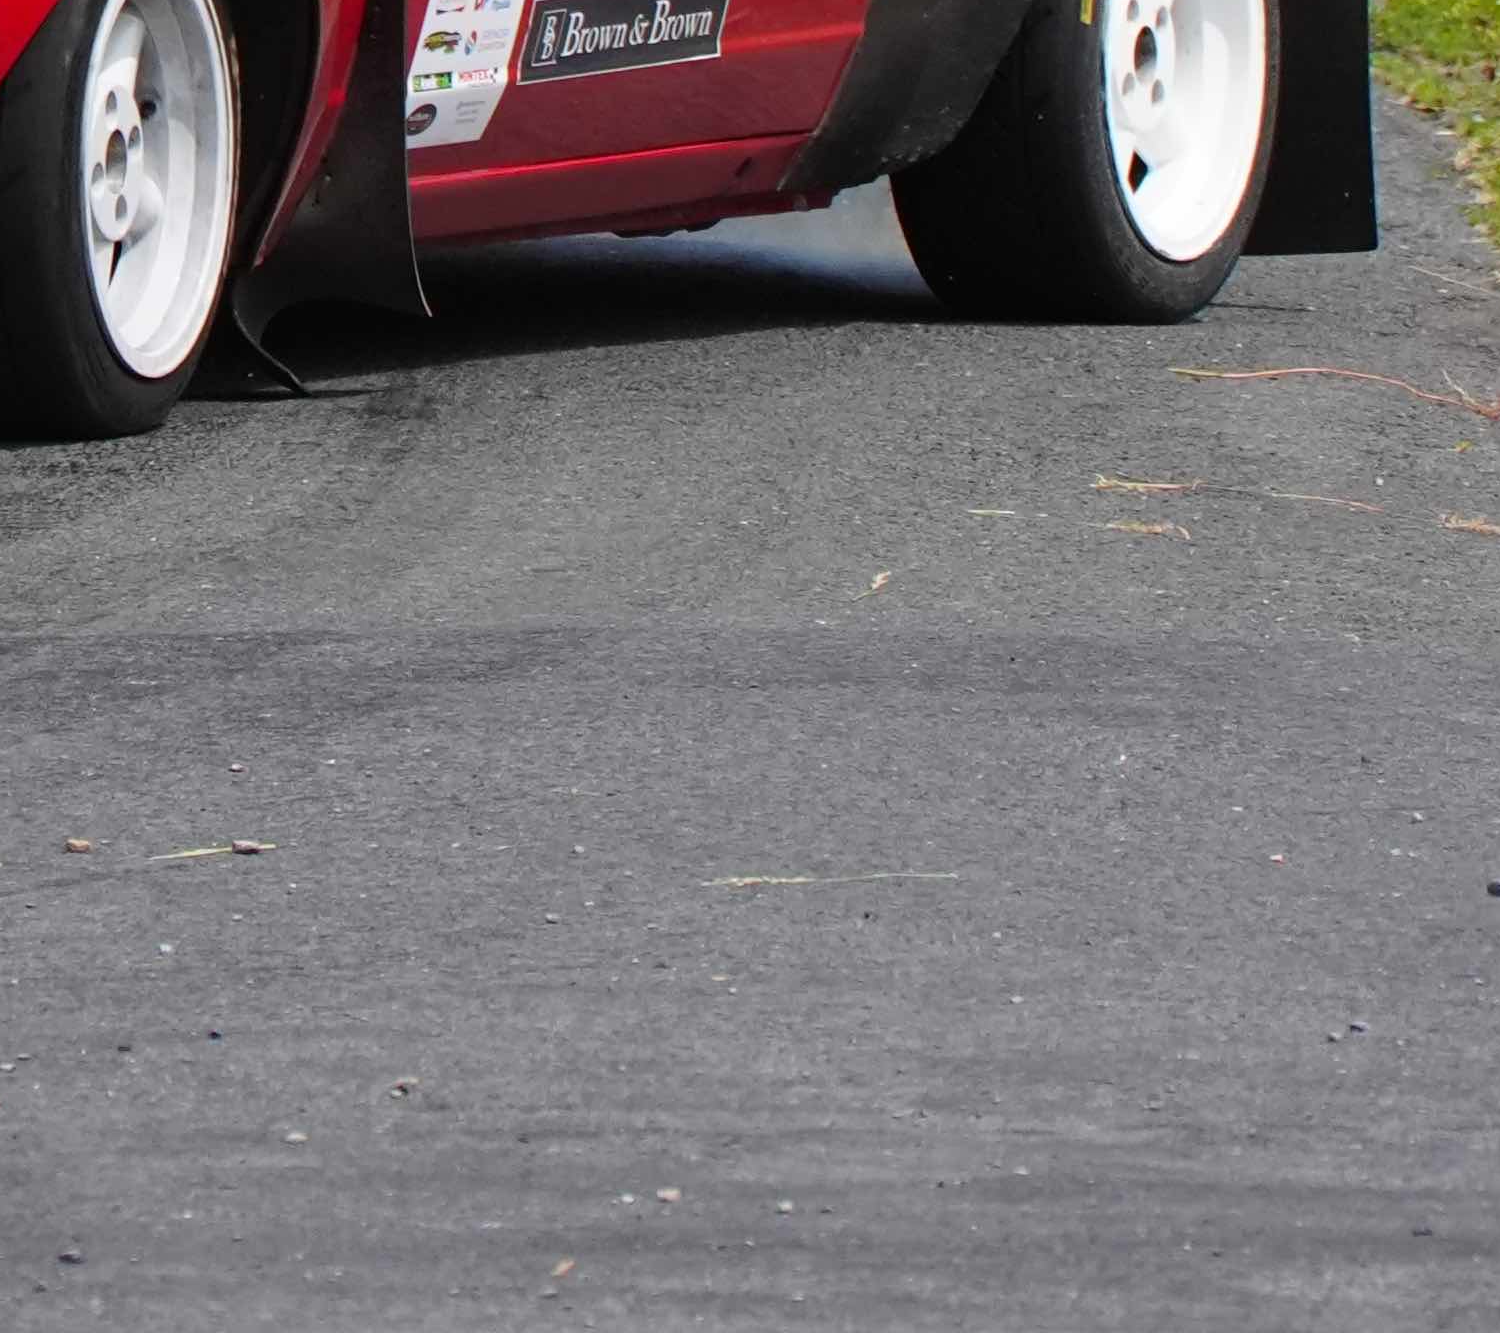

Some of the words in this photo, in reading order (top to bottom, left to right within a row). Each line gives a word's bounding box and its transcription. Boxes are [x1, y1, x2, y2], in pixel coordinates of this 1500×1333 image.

[560, 11, 628, 58] Brown
[628, 14, 650, 47] &
[648, 0, 713, 45] Brown
